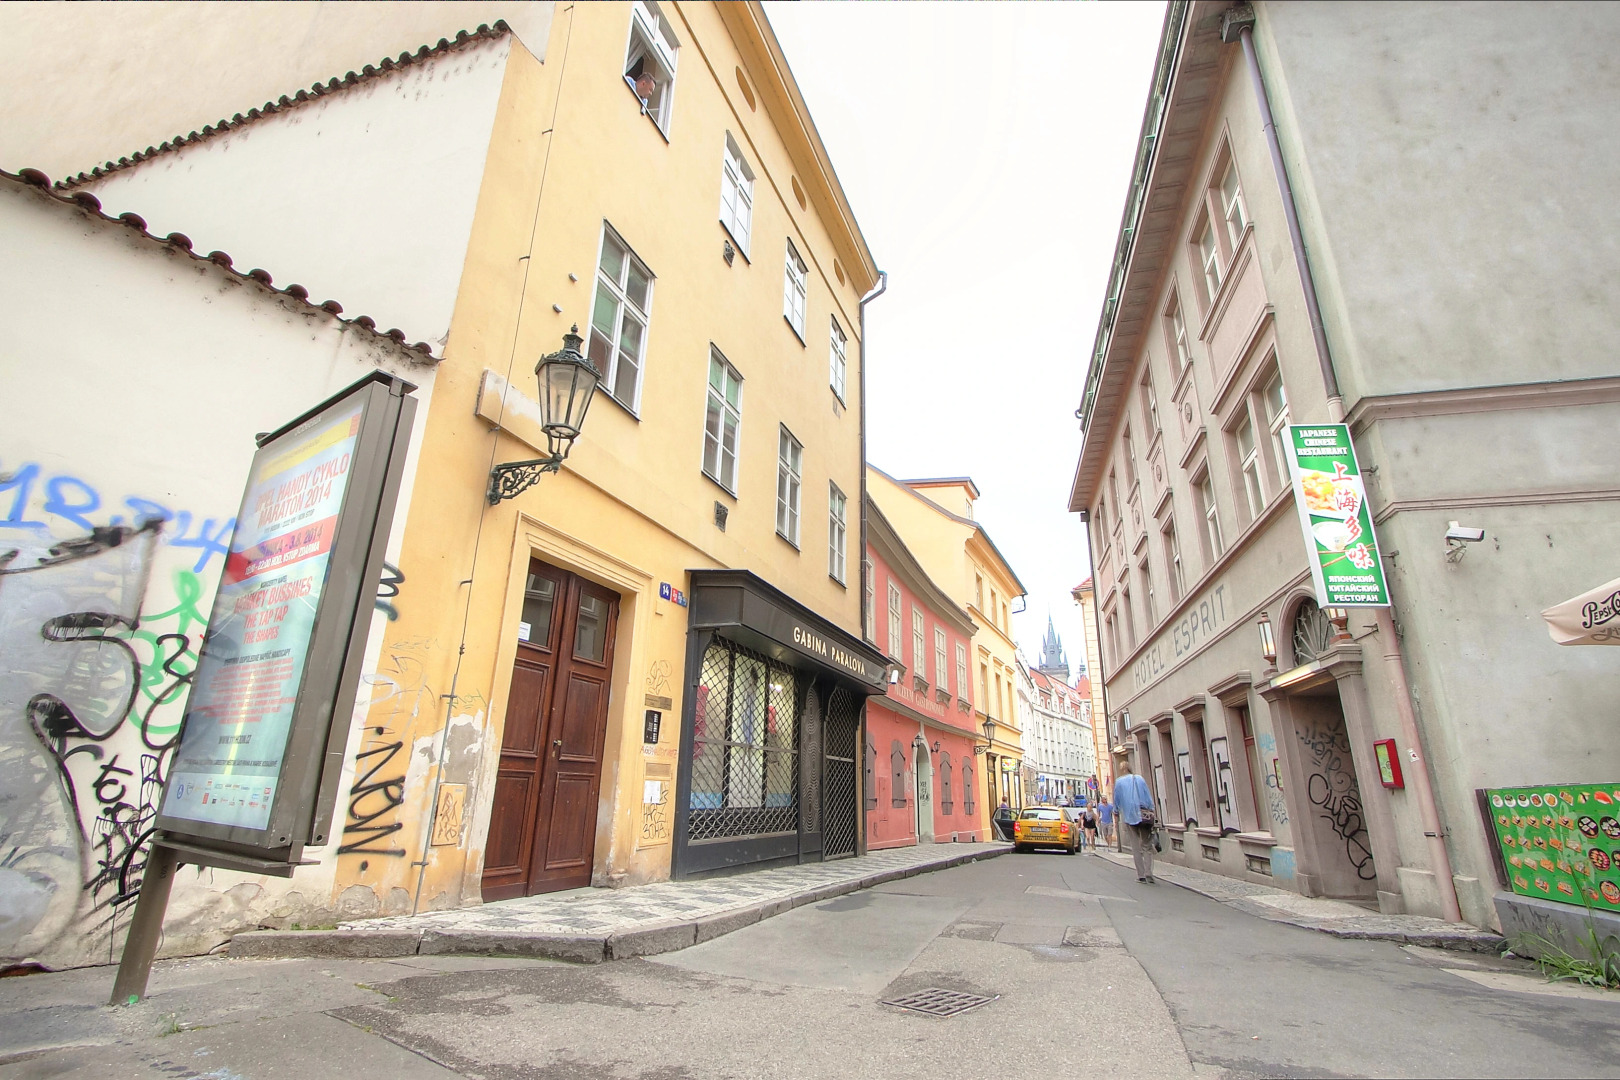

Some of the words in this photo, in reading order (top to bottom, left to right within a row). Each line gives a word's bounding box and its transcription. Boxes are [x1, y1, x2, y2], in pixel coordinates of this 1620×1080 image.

[1299, 429, 1337, 438] JAPANESE
[1304, 438, 1337, 447] CHINESE
[1296, 447, 1347, 456] RESTAURANT
[277, 470, 312, 502] HANDY
[312, 453, 350, 484] CYKLO
[258, 493, 305, 528] MARATON
[304, 480, 333, 509] 2014
[303, 524, 323, 545] 2014
[298, 541, 320, 558] ZDARMA
[1328, 575, 1375, 583] ЯПОНСКИЙ
[1328, 584, 1380, 592] КИТАЙСКИЙ
[267, 576, 313, 606] BUSSINES
[662, 585, 669, 597] 14
[244, 613, 257, 629] THE
[258, 608, 274, 625] TAP
[273, 605, 289, 622] TAP
[243, 630, 255, 645] THE
[255, 625, 280, 642] SHAPES
[1133, 644, 1165, 690] HOTEL
[1173, 584, 1226, 657] ESPRIT
[793, 626, 827, 657] GABINA
[831, 646, 866, 676] PARALOVA
